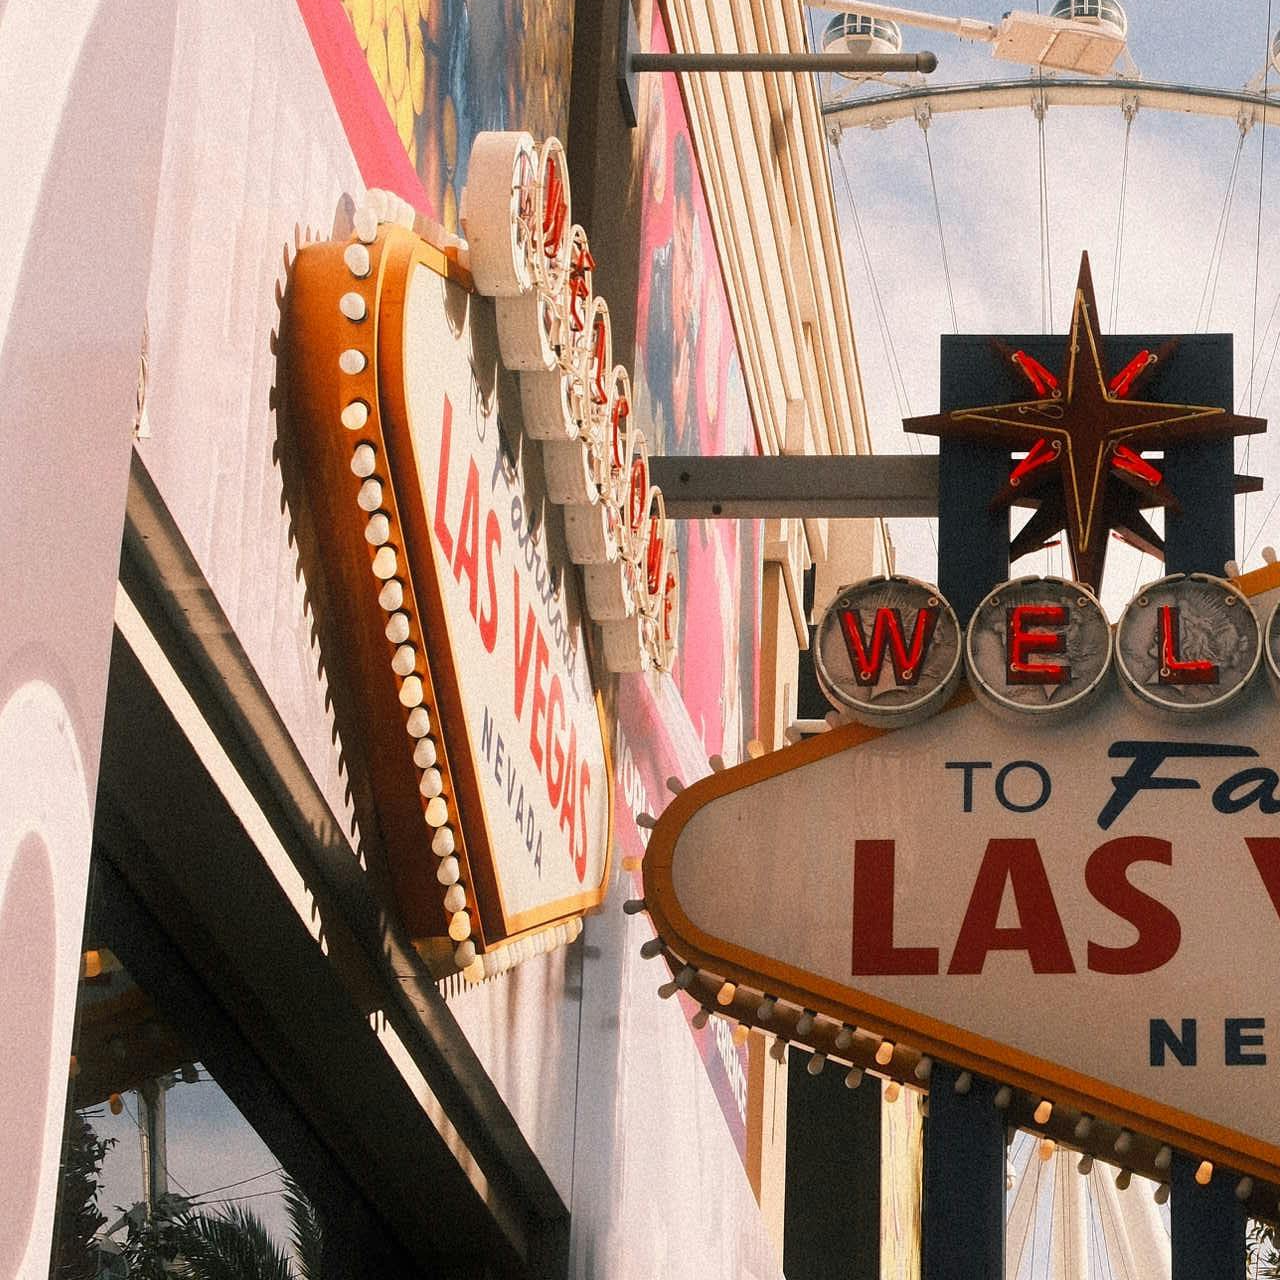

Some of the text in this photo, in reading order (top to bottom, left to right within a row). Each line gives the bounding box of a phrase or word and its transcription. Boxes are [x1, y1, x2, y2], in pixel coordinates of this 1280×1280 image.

[434, 392, 591, 884] LAS VEGAS
[481, 705, 542, 879] NEVADA
[944, 760, 1052, 814] TO
[851, 836, 1182, 977] LAS
